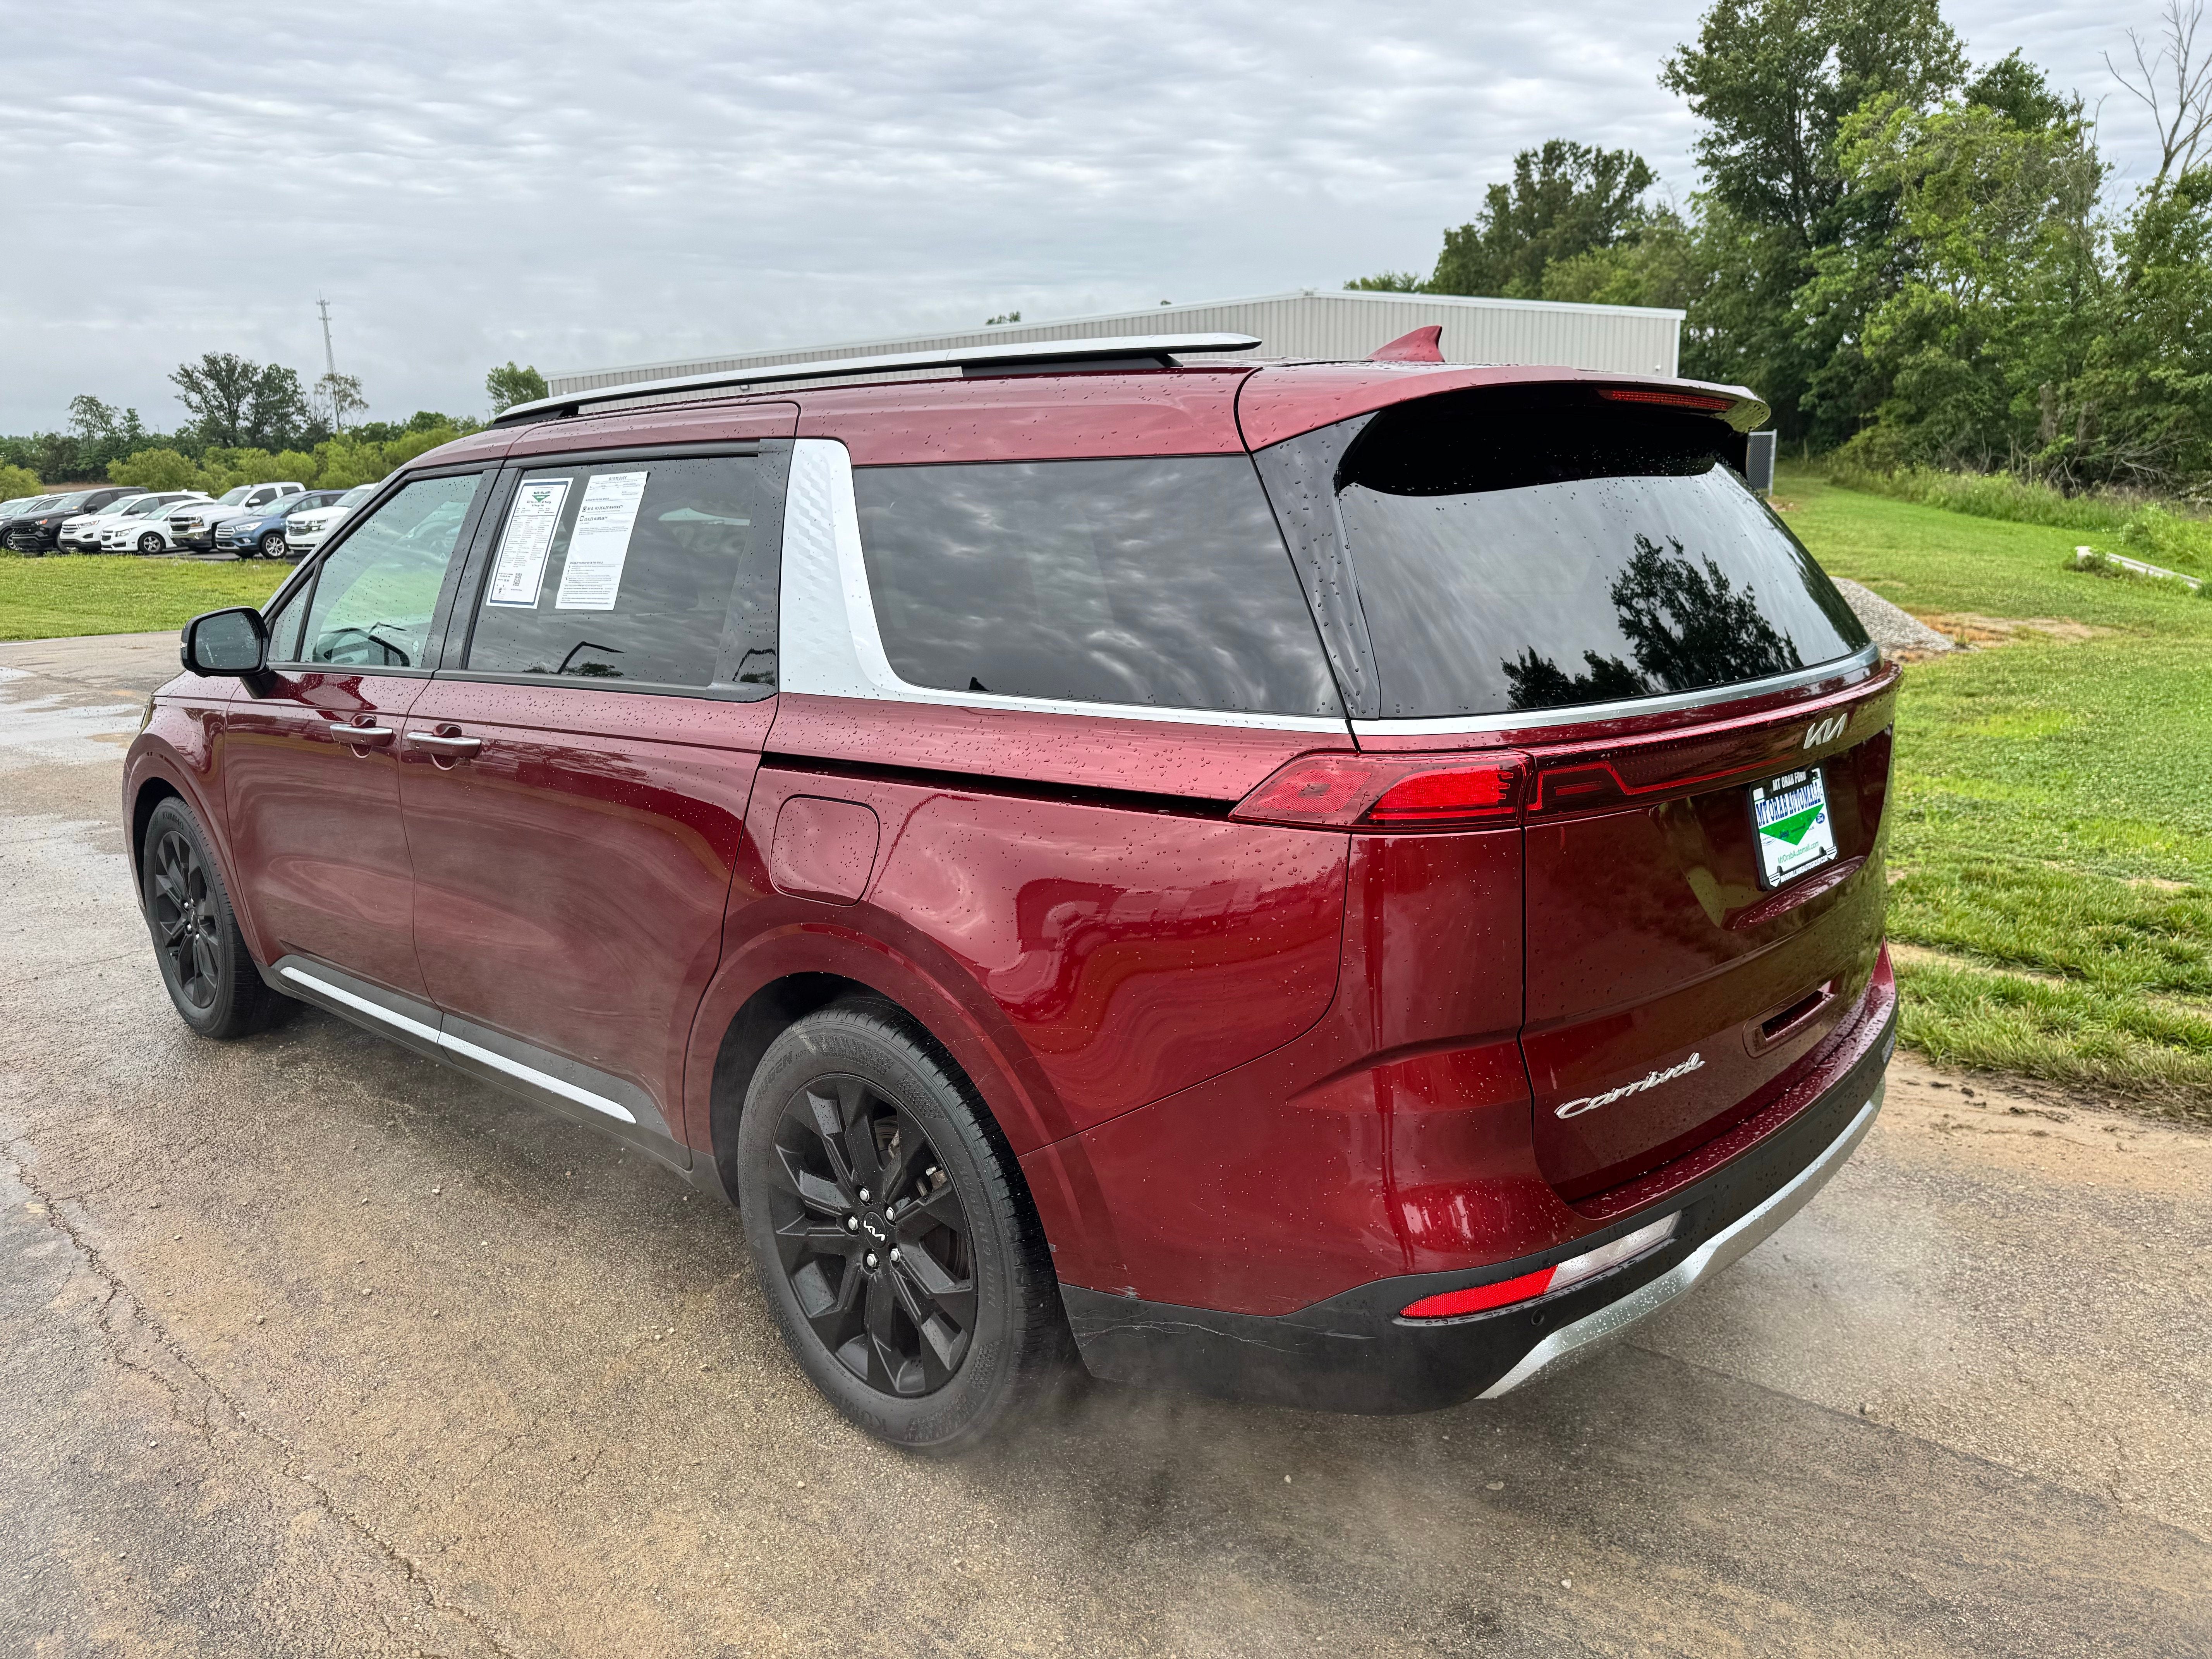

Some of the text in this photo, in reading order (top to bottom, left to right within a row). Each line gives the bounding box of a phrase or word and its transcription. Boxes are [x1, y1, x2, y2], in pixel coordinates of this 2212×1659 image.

[1803, 713, 1848, 749] KIA
[1772, 778, 1780, 791] MT
[1781, 773, 1795, 788] ORAB
[163, 811, 184, 830] KUMHO
[1756, 801, 1769, 826] MT
[1769, 795, 1788, 821] ORAB
[1554, 1053, 1705, 1119] Carnival
